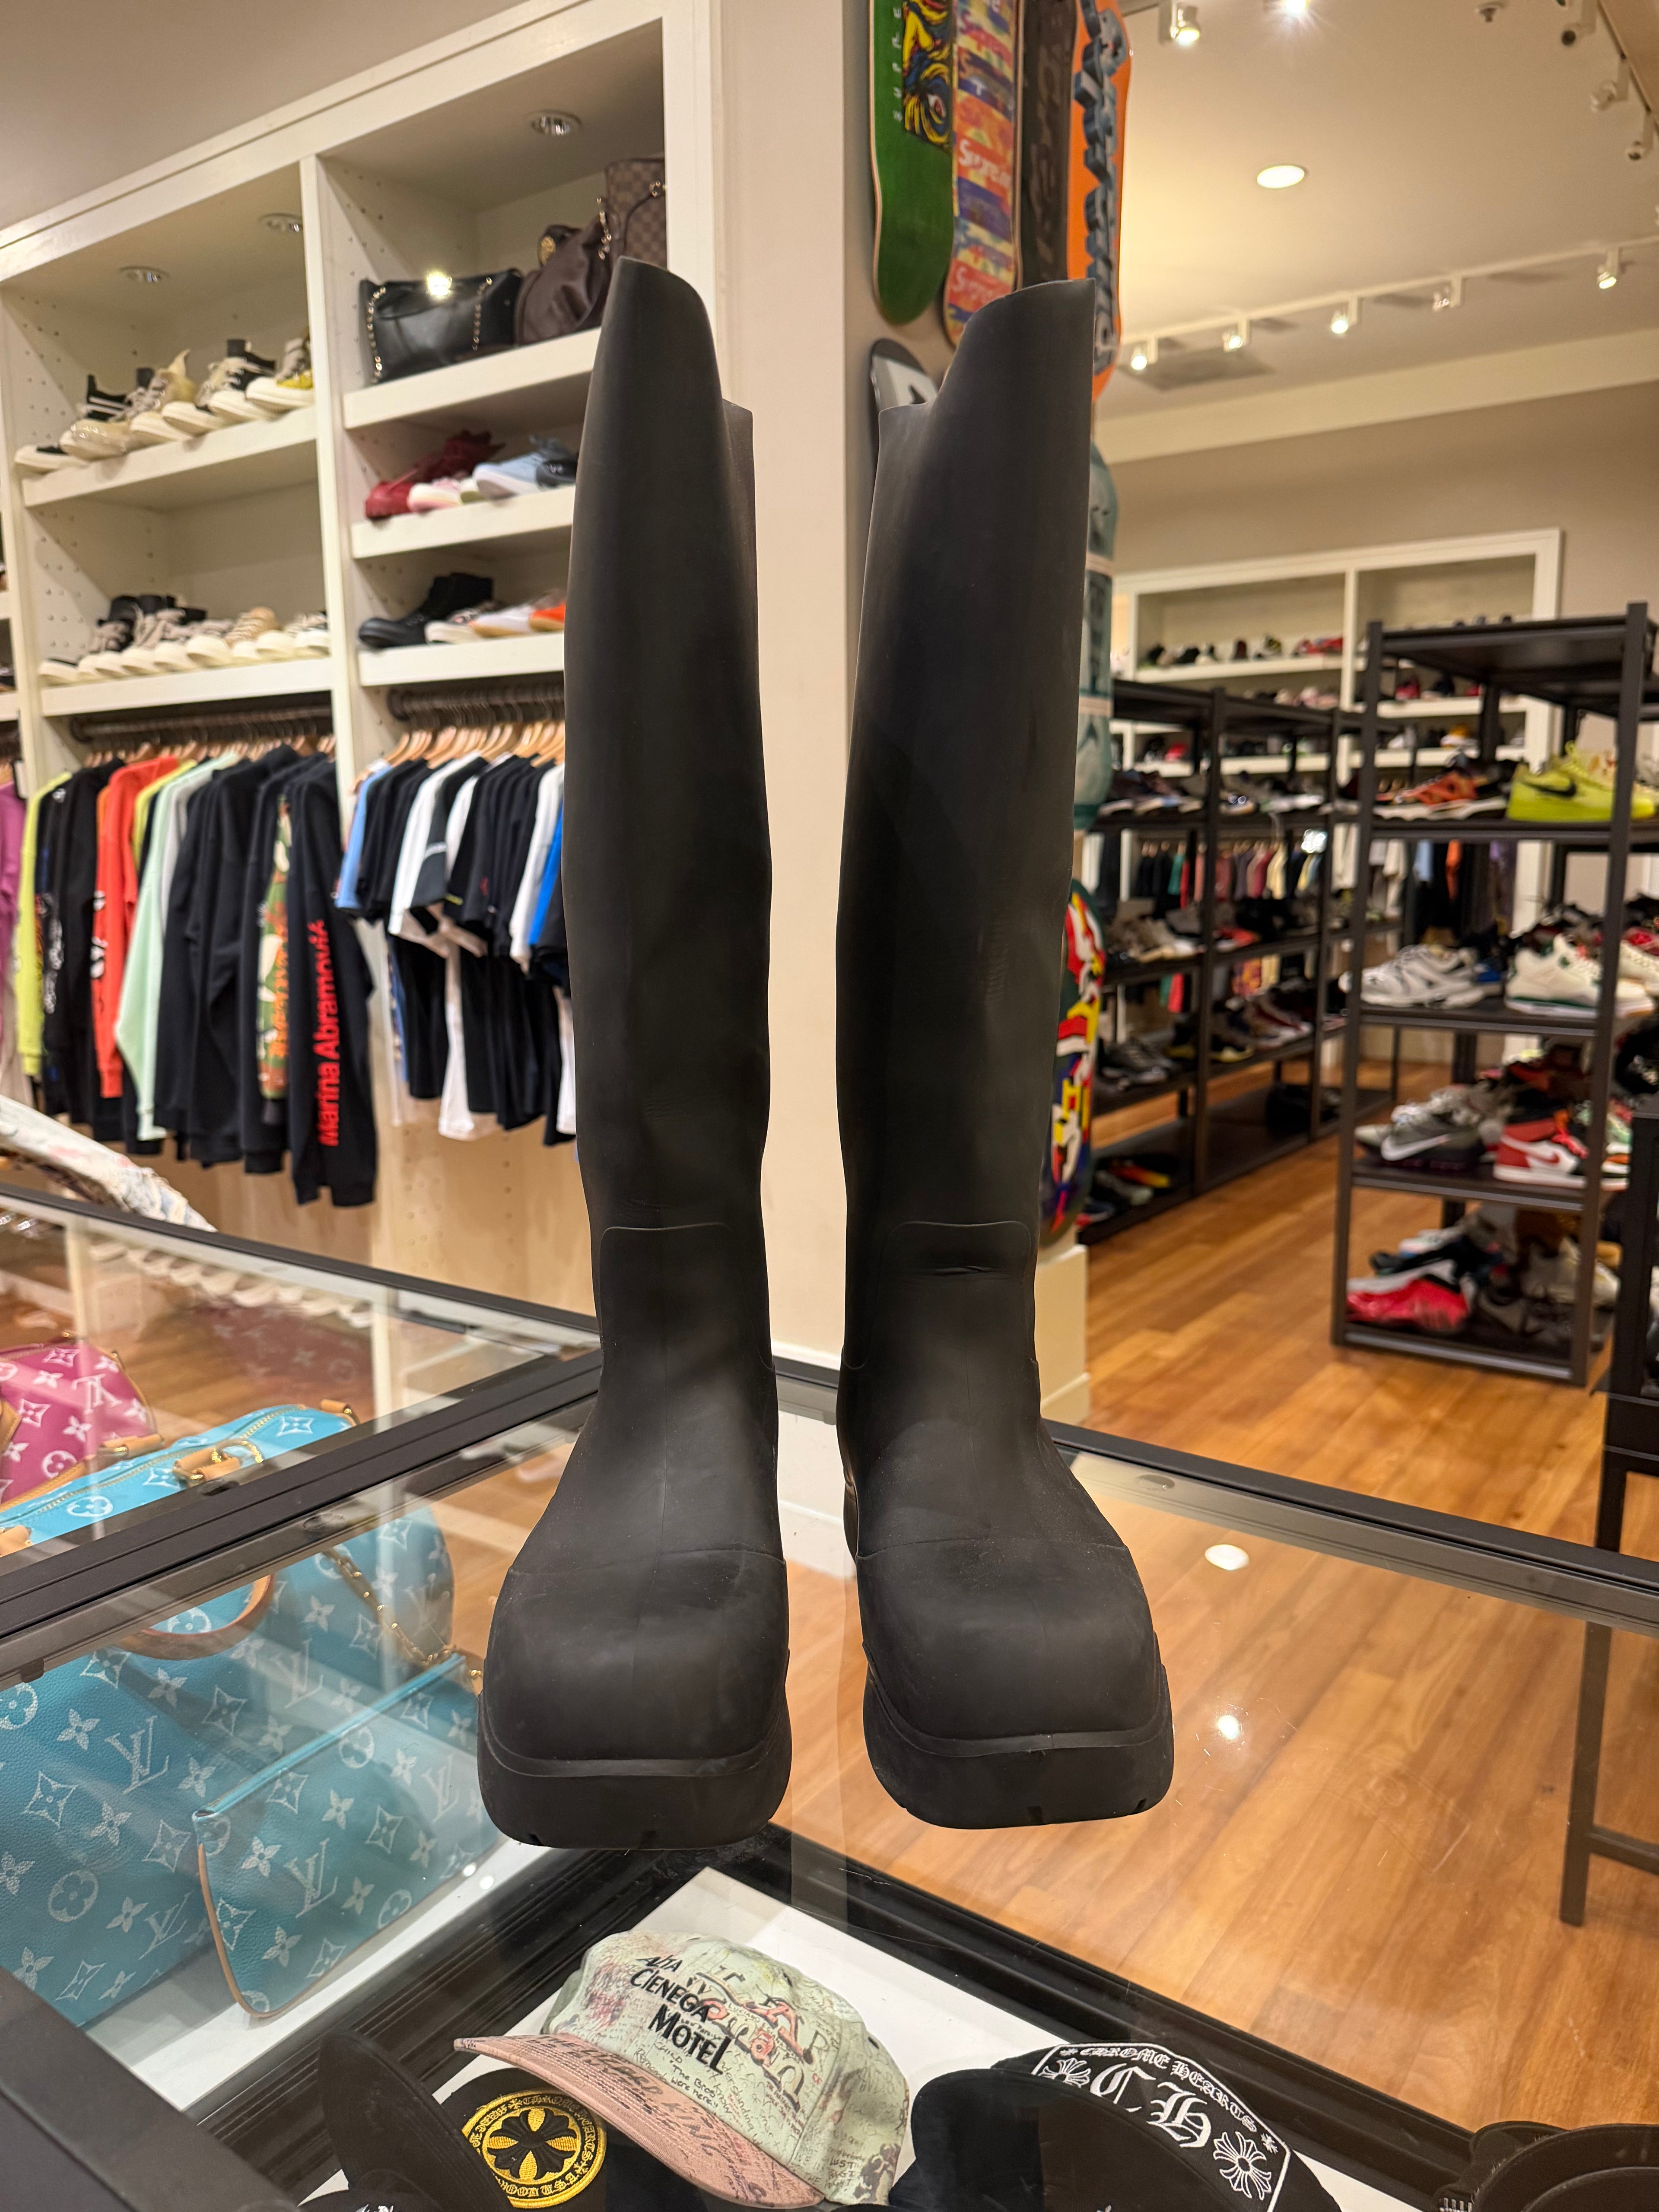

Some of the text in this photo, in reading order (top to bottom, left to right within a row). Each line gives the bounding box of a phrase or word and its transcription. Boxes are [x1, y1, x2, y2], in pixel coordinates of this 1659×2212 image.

[317, 1062, 340, 1146] Marina
[636, 1955, 683, 1972] ALTA
[630, 1968, 711, 2023] CIENEGA
[648, 2003, 732, 2075] MOTEL
